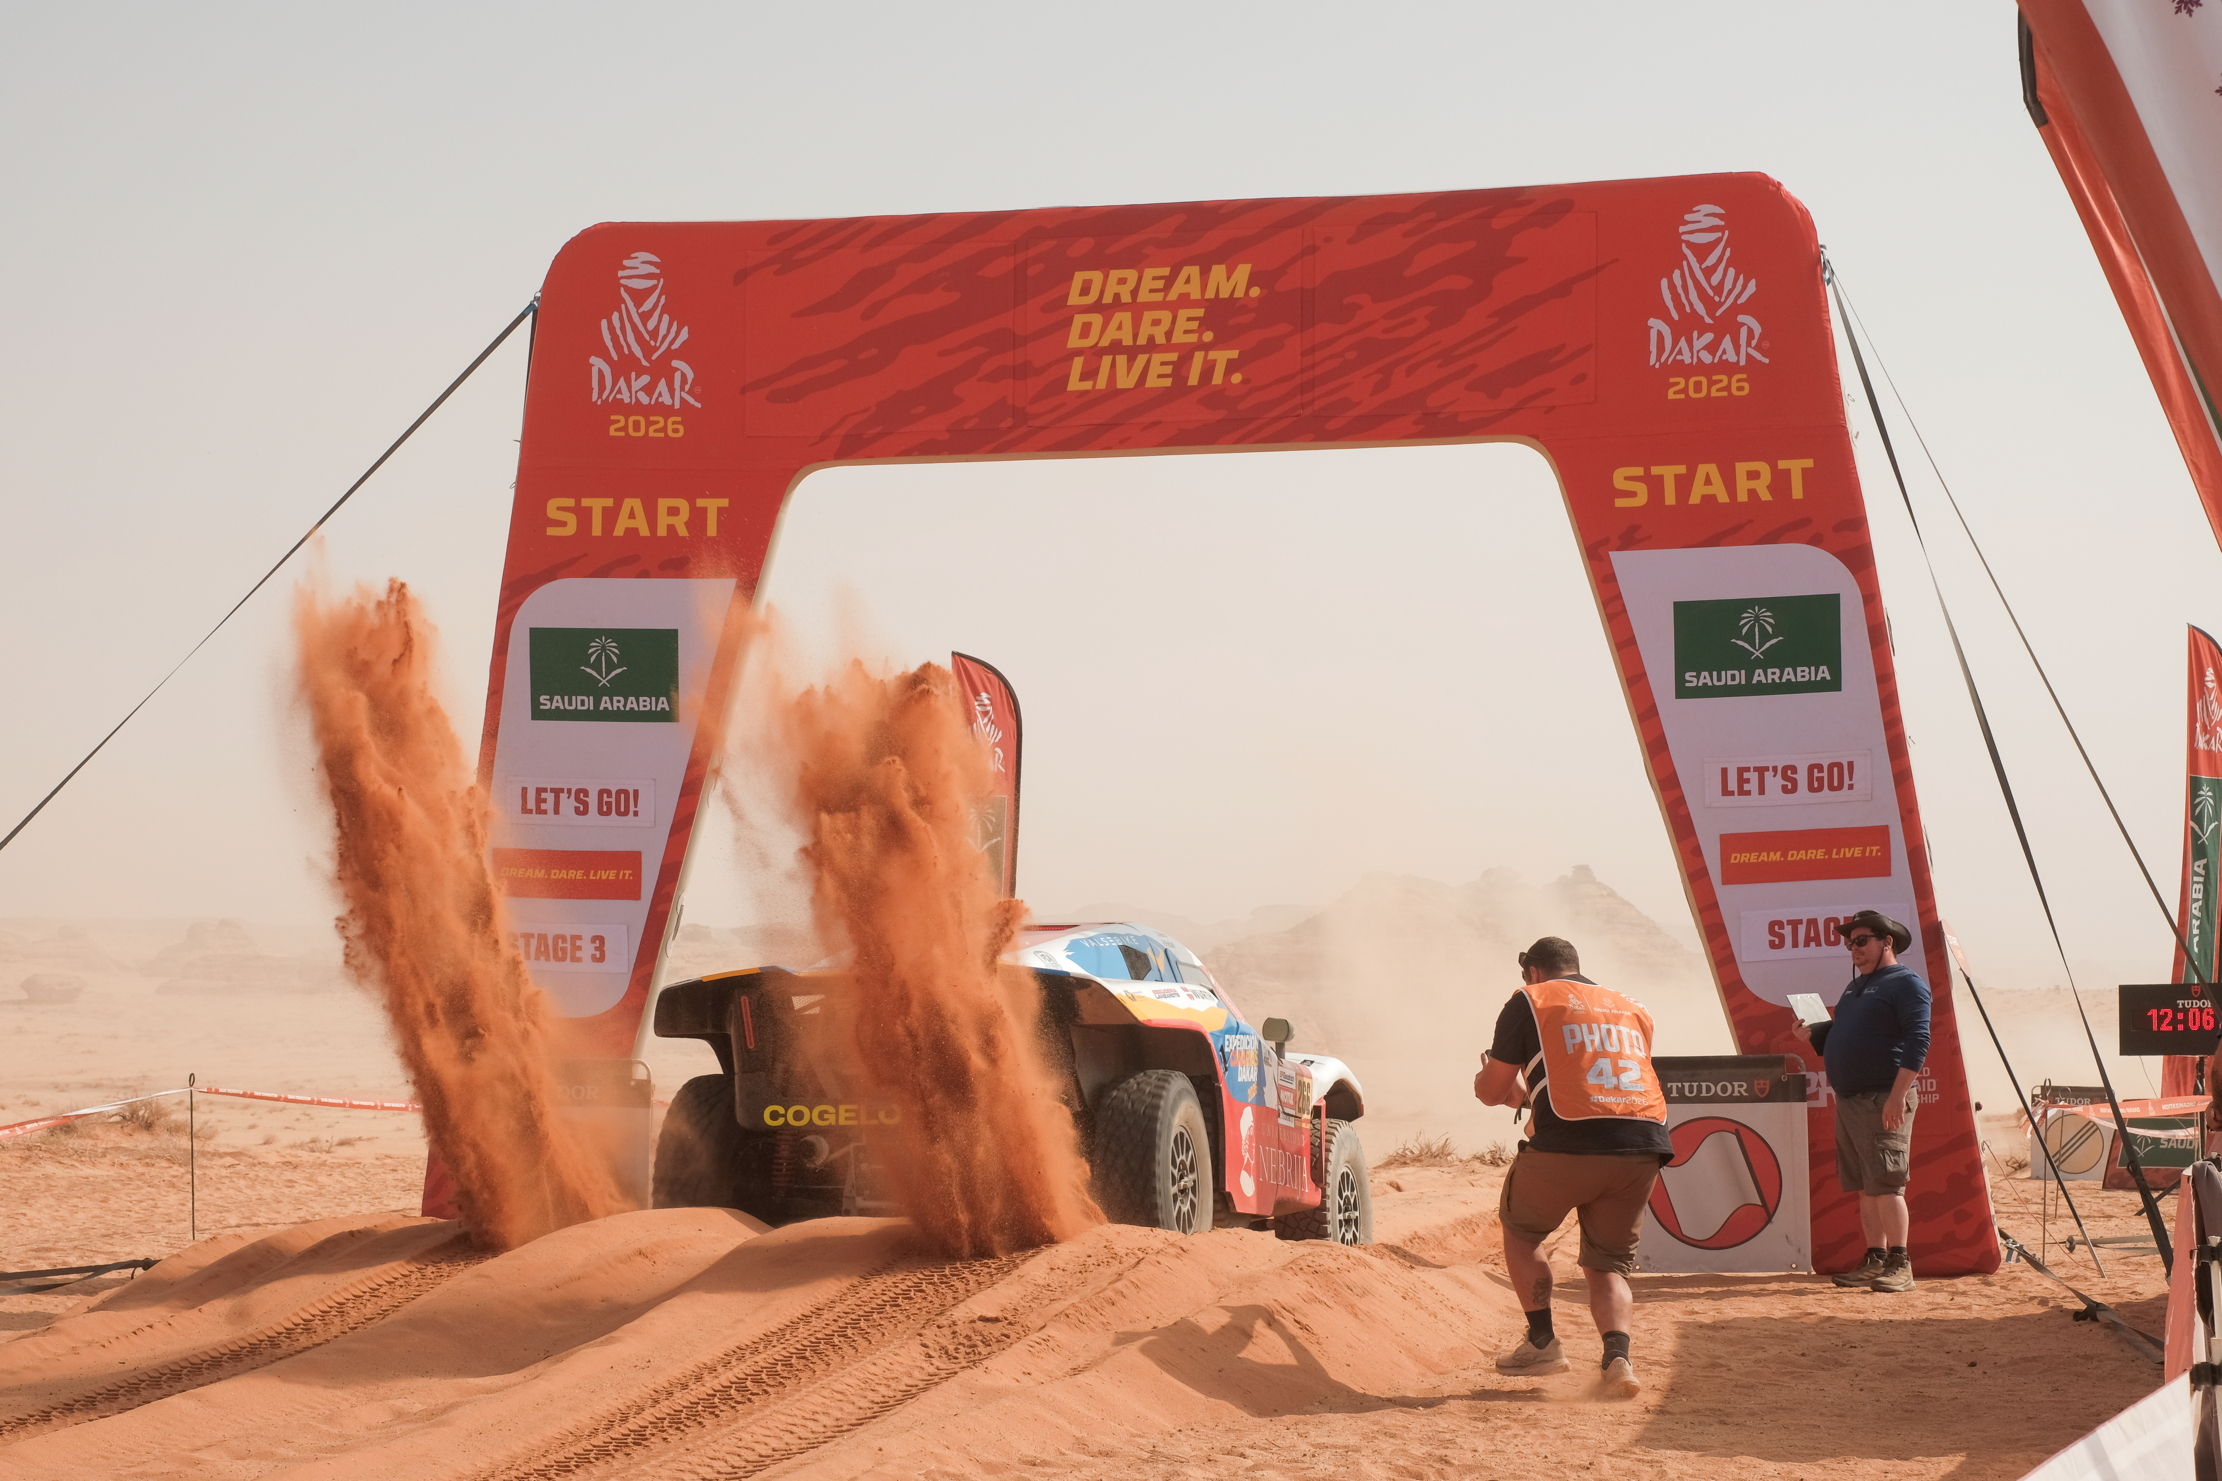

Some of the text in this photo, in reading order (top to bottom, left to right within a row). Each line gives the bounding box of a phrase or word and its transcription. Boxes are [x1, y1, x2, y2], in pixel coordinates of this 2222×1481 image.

[1067, 264, 1261, 305] DREAM.
[1067, 308, 1214, 348] DARE.
[1647, 315, 1769, 368] DAKAR
[589, 356, 702, 409] DAKAR
[1067, 350, 1243, 391] LIVE IT.
[1667, 374, 1749, 399] 2026
[609, 415, 684, 437] 2026
[1613, 459, 1814, 507] START
[546, 498, 729, 536] START
[1685, 666, 1831, 686] SAUDI ARABIA
[539, 695, 670, 711] SAUDI ARABIA
[1721, 761, 1854, 796] LET'S GO!
[521, 787, 639, 817] LET'S GO!
[1730, 846, 1882, 863] DREAM. DARE. LIVE IT.
[501, 867, 633, 880] DREAM. DARE. LIVE IT.
[590, 935, 606, 963] 3
[1562, 1023, 1647, 1058] PHOTO
[1586, 1058, 1645, 1091] 42
[1667, 1081, 1749, 1097] TUDOR
[1590, 1096, 1649, 1106] #Dakar2026
[2160, 1137, 2197, 1149] SAUD
[1259, 1145, 1309, 1199] NEBRIJA
